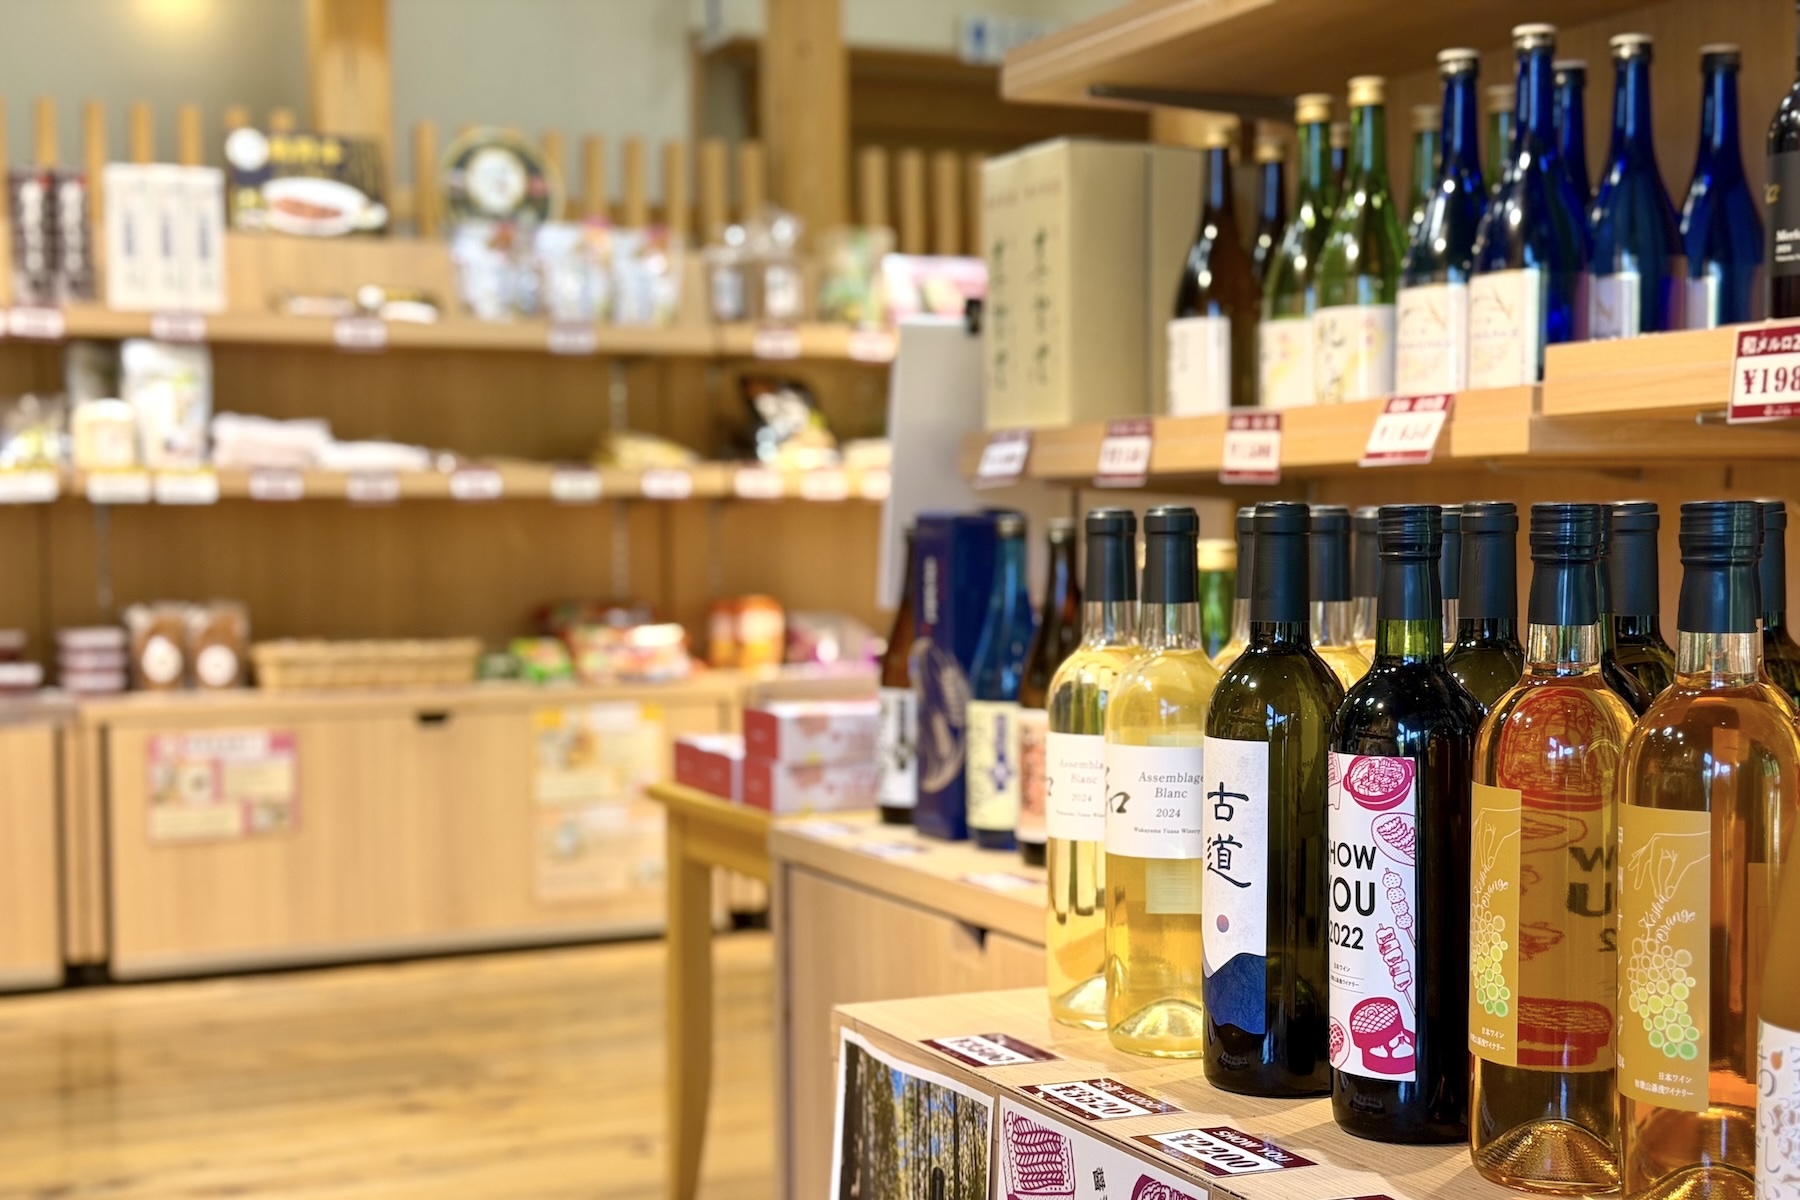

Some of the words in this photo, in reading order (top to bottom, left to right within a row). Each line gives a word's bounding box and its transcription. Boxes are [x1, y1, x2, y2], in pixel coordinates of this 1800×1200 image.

[1155, 787, 1188, 798] Blanc
[1155, 807, 1181, 818] 2024
[1207, 782, 1252, 888] 古道
[1330, 841, 1376, 870] HOW
[1638, 895, 1669, 930] Koshu
[1330, 921, 1364, 950] 2022
[1658, 1071, 1693, 1084] 日本ワイン
[1051, 1084, 1132, 1115] ¥3520
[1167, 1133, 1260, 1168] ¥2200
[1213, 1130, 1263, 1149] SHOW
[1258, 1147, 1294, 1163] YOU
